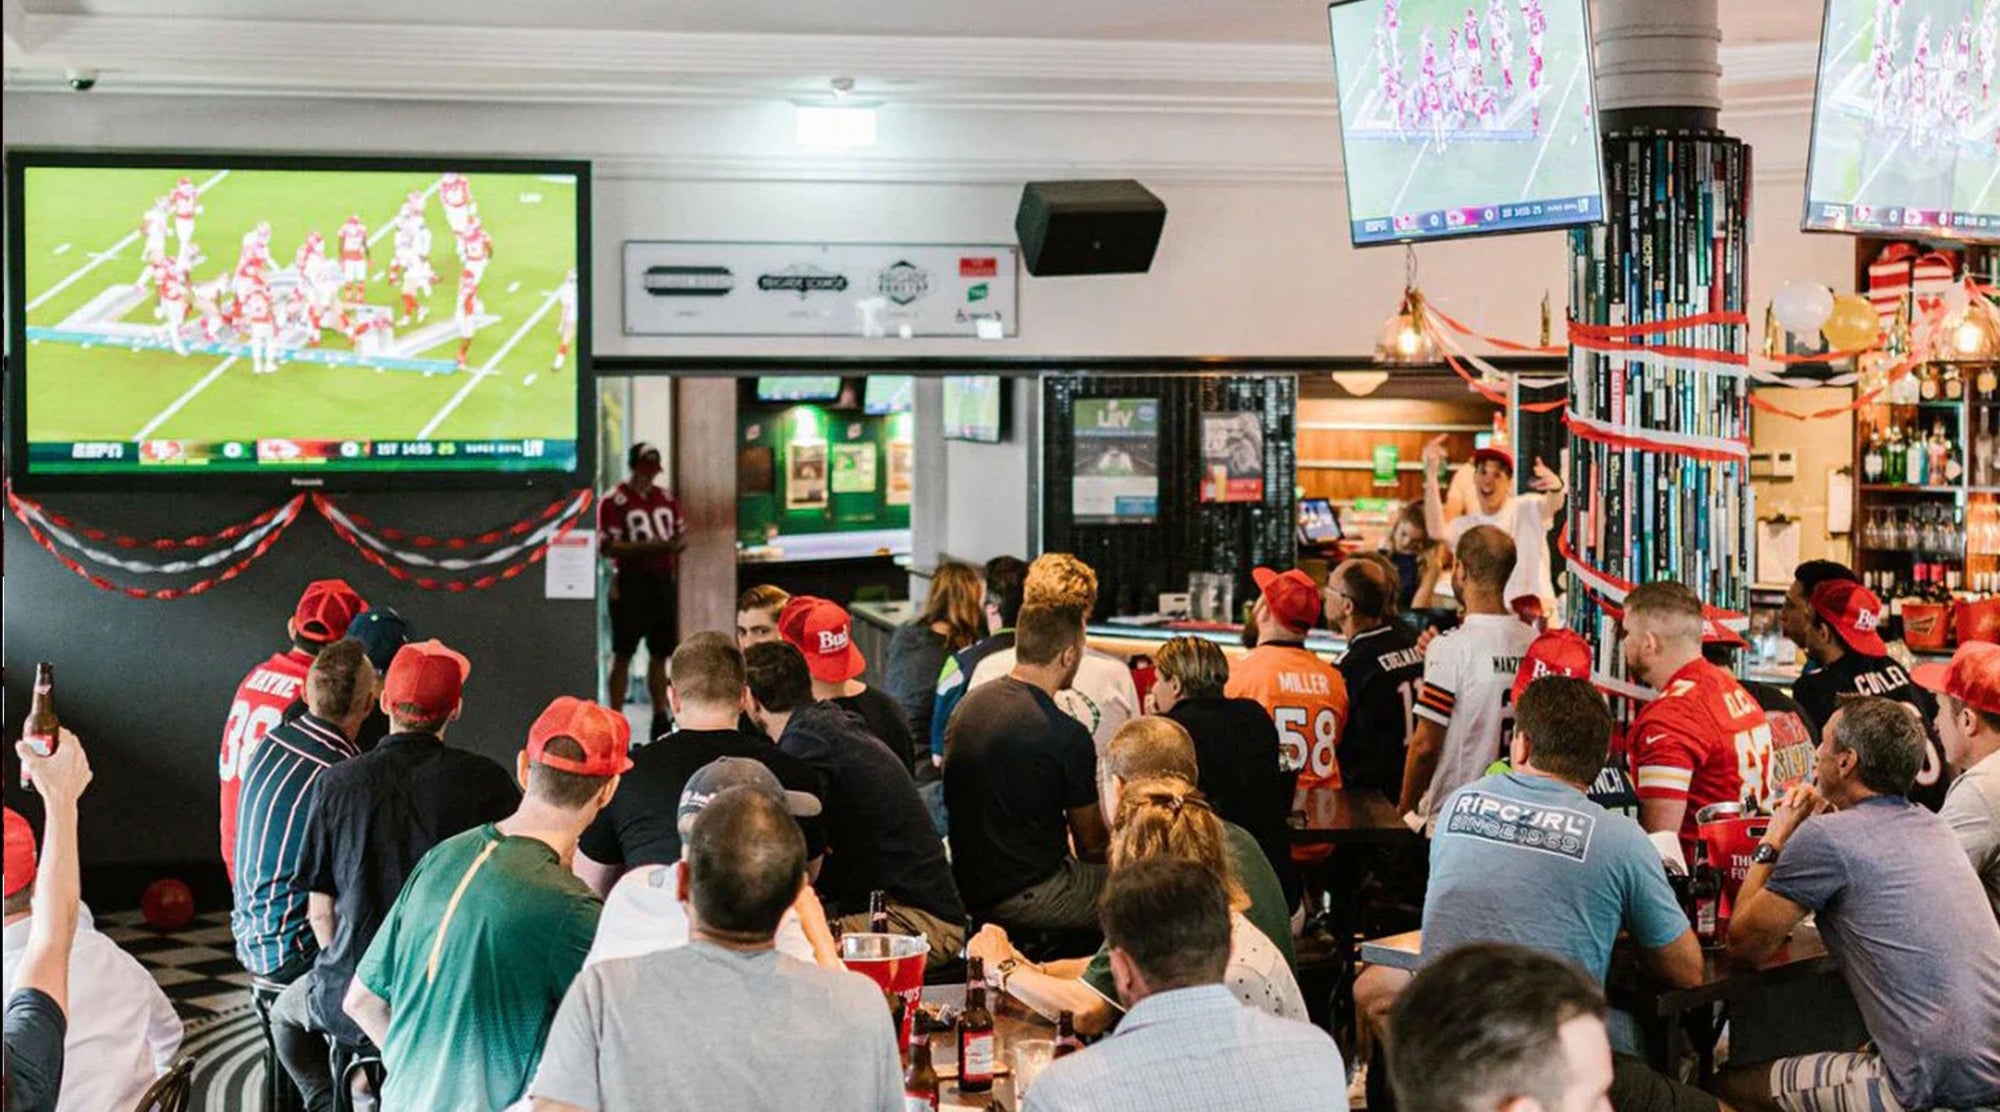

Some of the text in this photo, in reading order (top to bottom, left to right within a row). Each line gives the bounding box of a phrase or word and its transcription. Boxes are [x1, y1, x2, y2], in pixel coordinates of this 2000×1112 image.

[1430, 215, 1439, 226] 0
[1484, 209, 1494, 221] 0
[71, 443, 124, 458] ESPN
[223, 442, 243, 458] 0
[340, 441, 359, 457] 0
[377, 443, 398, 455] 1ST
[627, 507, 674, 542] 80
[818, 624, 848, 648] Bud
[1278, 672, 1330, 695] MILLER
[1275, 707, 1336, 778] 58
[1450, 814, 1581, 853] SINCE 1969
